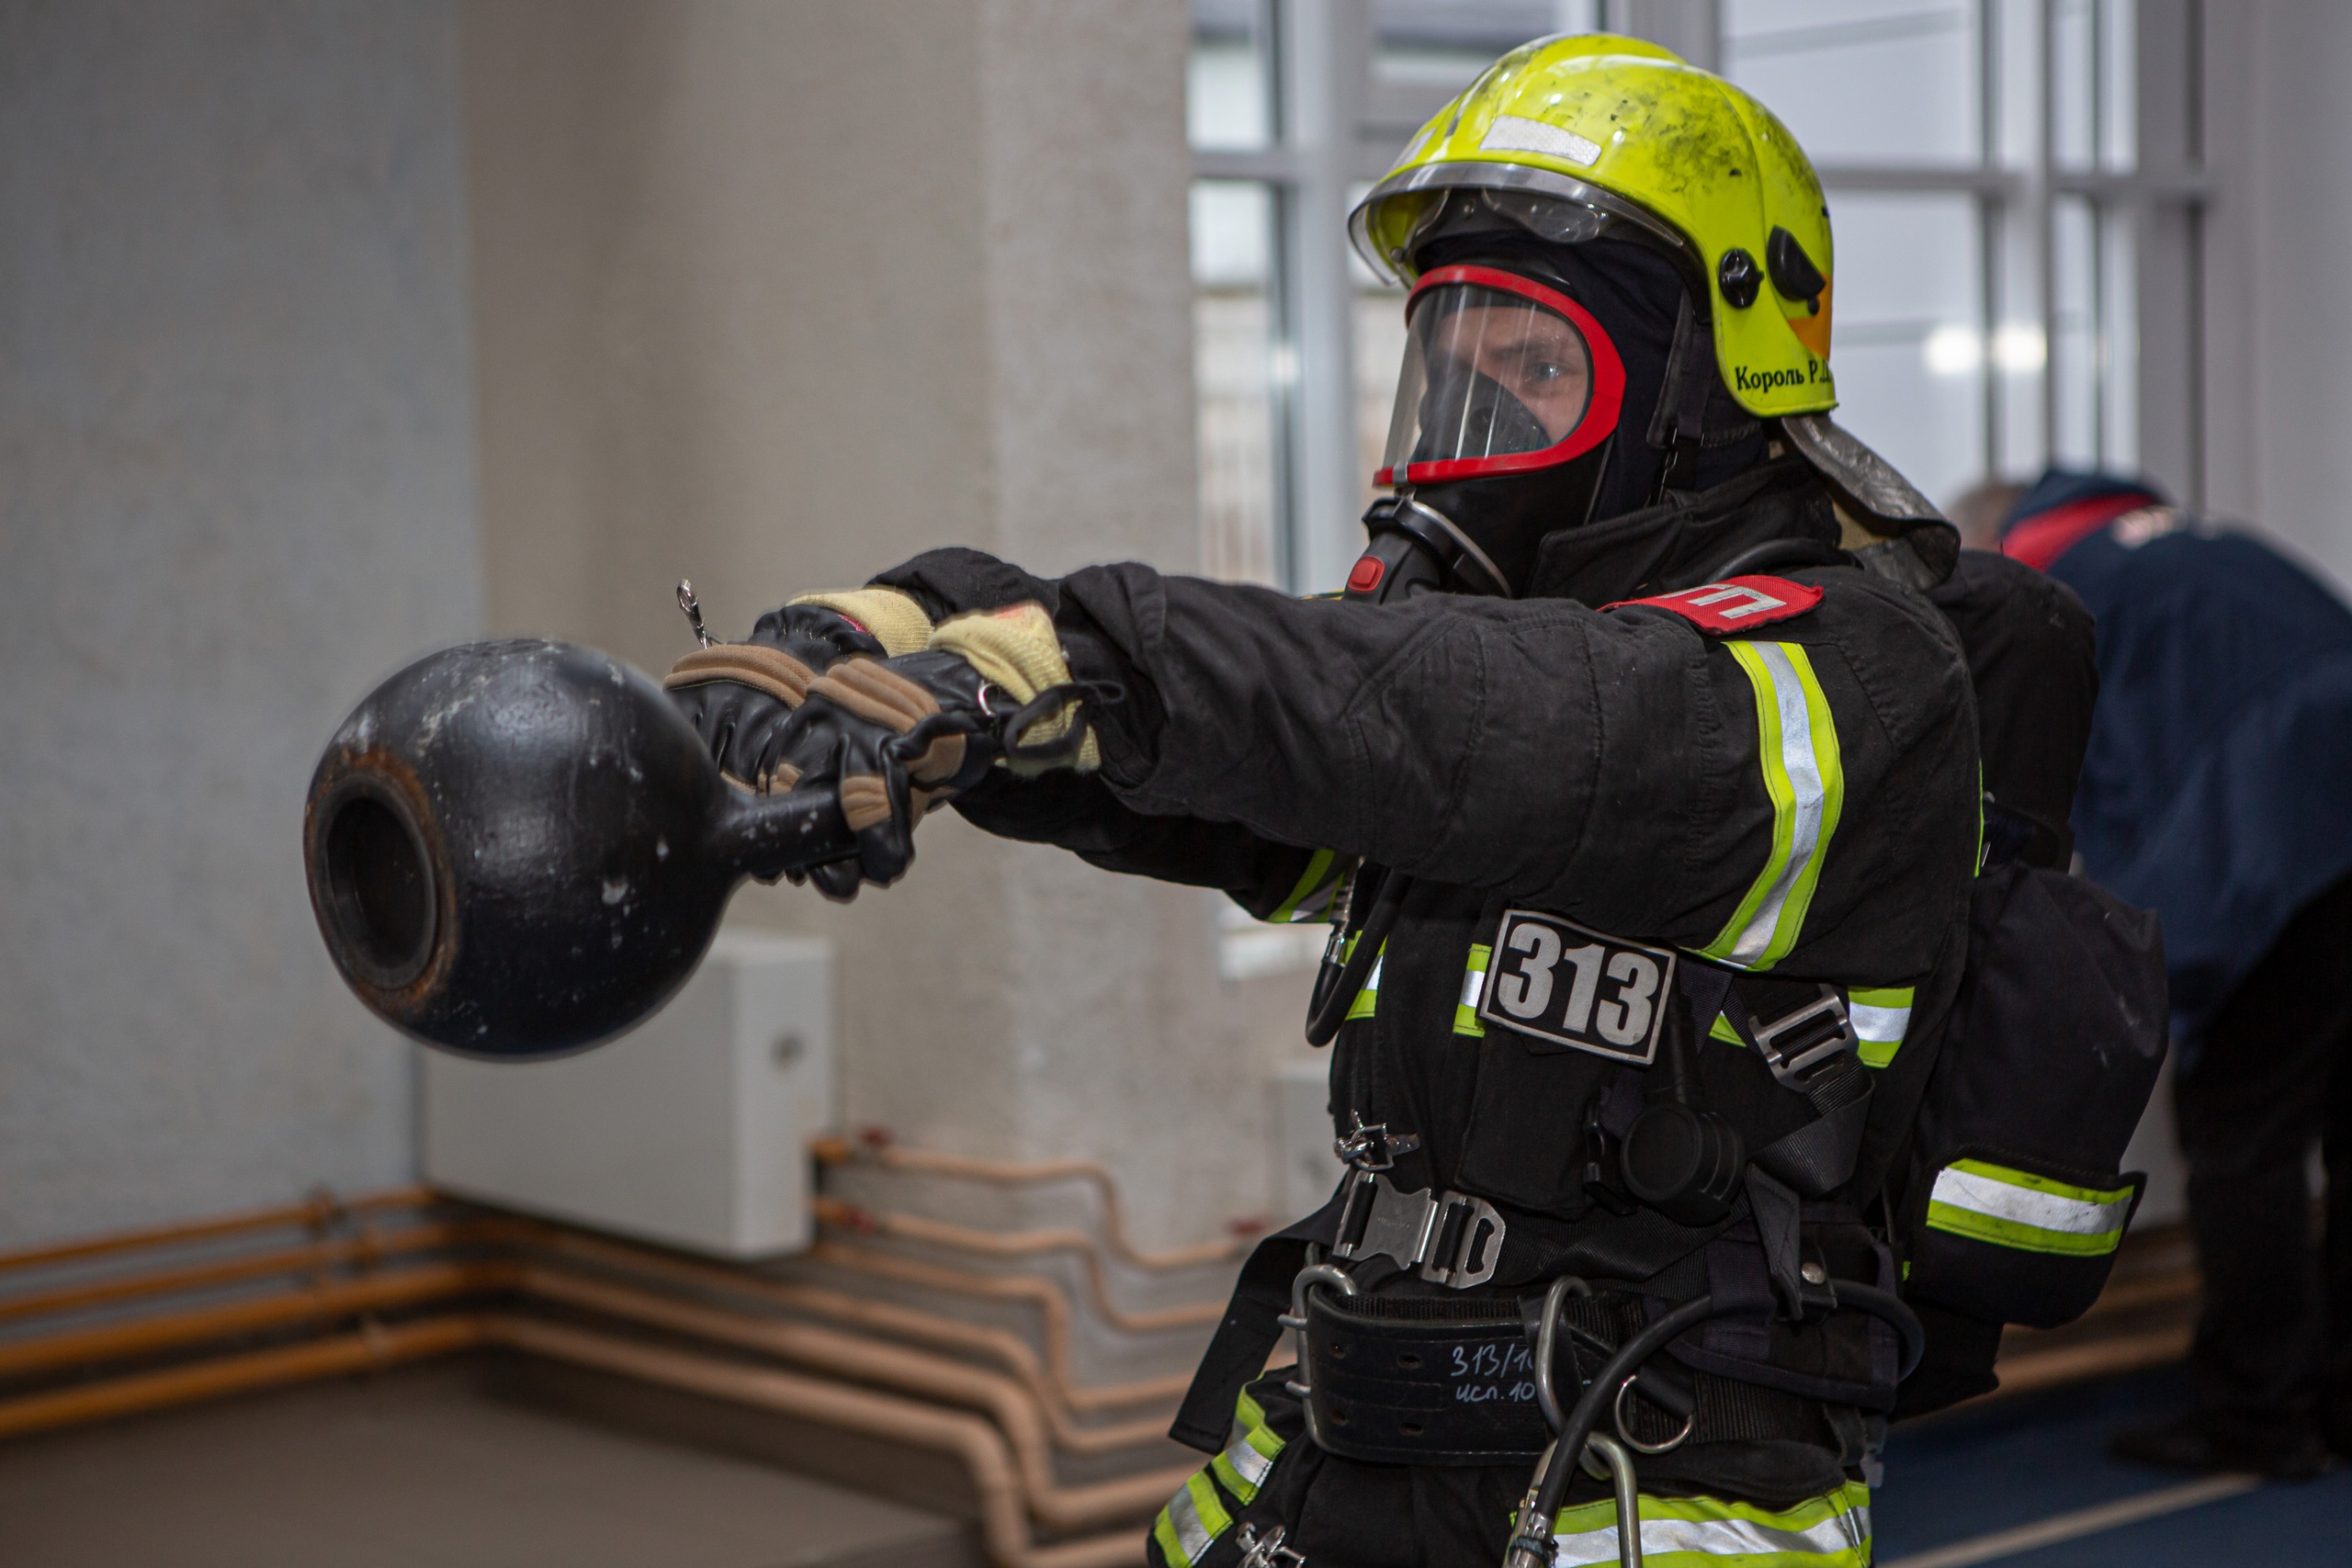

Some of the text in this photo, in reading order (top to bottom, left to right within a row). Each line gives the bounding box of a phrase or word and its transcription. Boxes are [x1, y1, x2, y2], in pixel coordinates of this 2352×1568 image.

[1735, 366, 1804, 393] Король
[1498, 922, 1659, 1046] 313
[1451, 1343, 1533, 1378] 313/1
